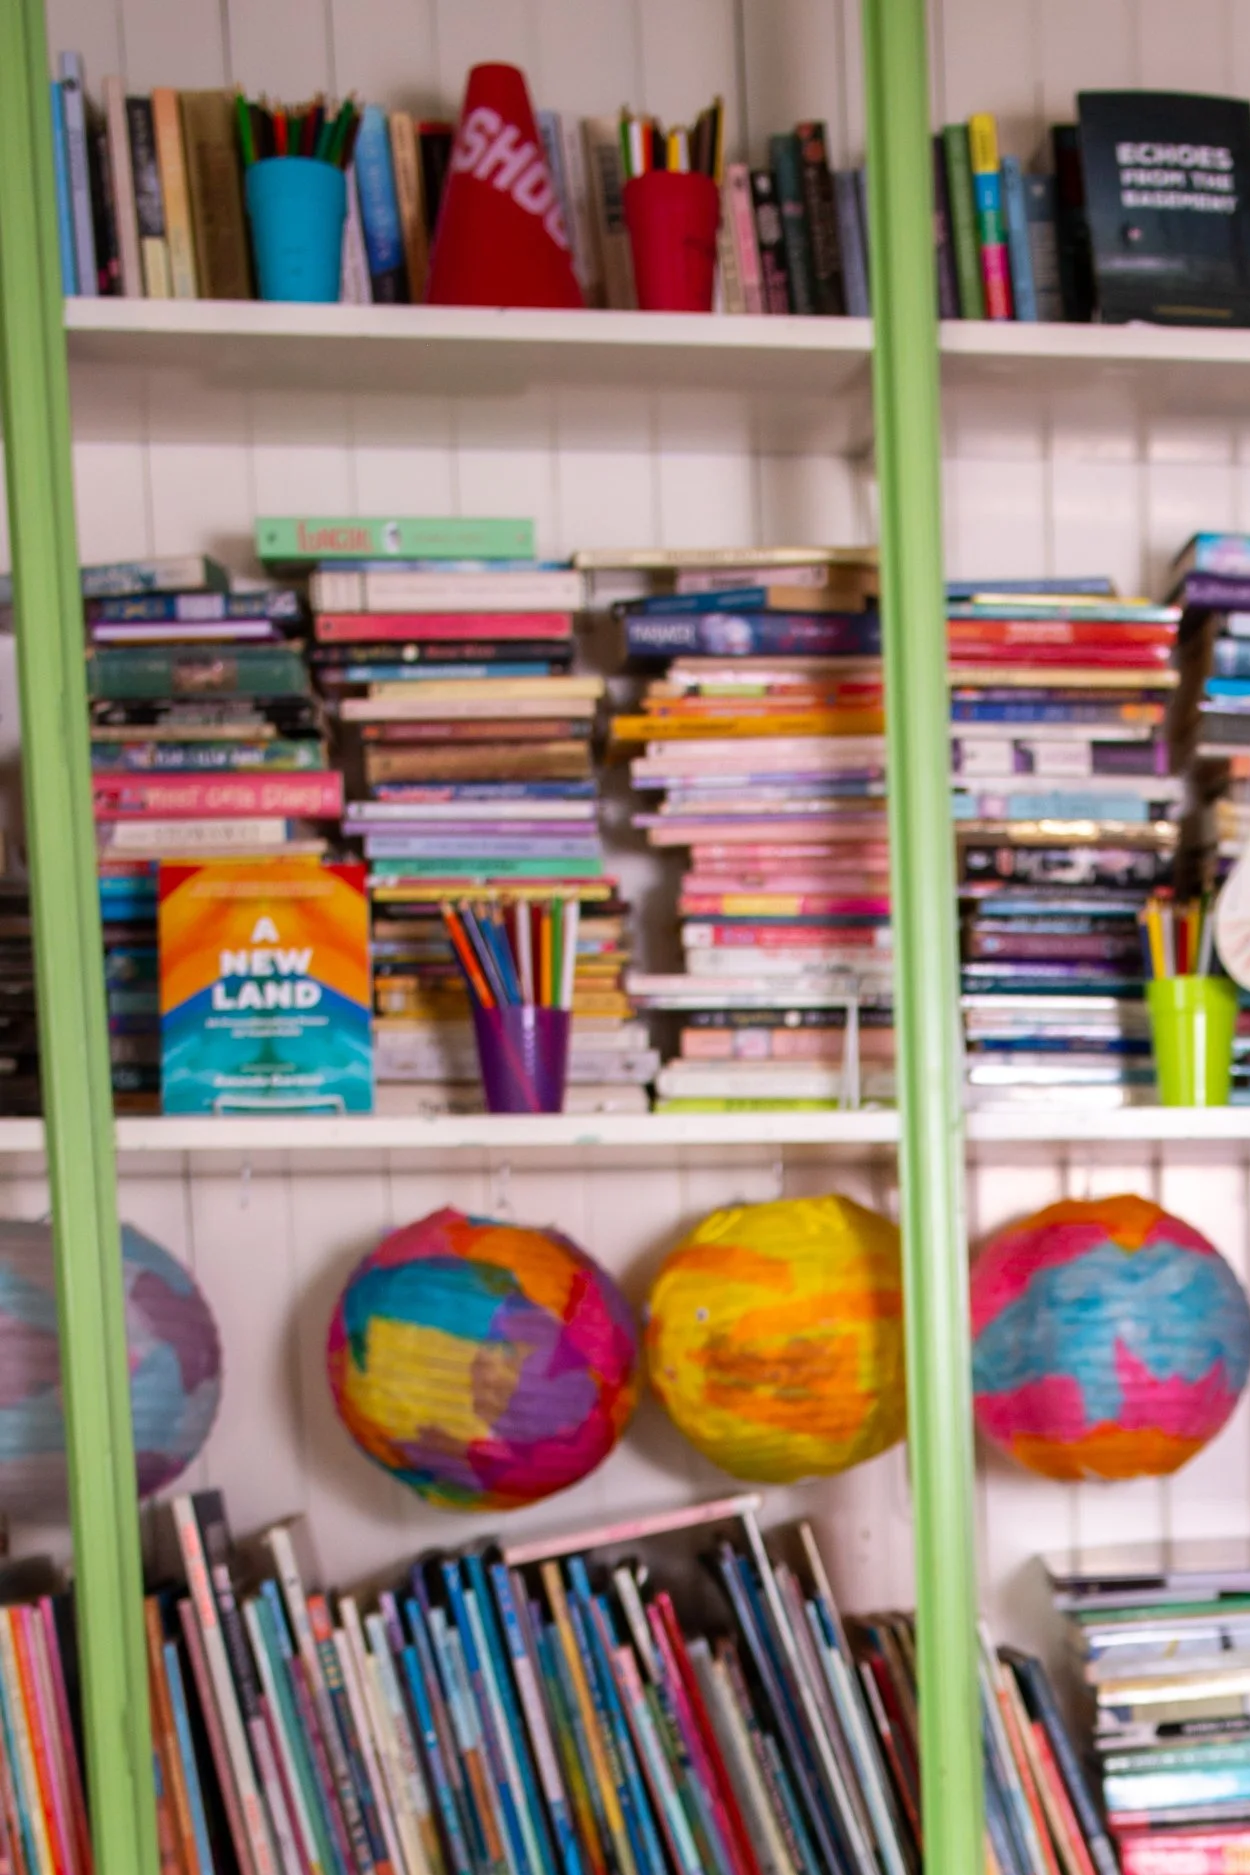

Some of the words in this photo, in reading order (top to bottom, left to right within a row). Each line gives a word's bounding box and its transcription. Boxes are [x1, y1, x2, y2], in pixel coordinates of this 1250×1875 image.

[1116, 142, 1234, 170] ECHOES
[1120, 167, 1186, 188] FROM
[1190, 171, 1235, 192] THE
[1121, 189, 1238, 214] BASEMENT
[251, 916, 279, 943] A
[219, 948, 313, 976] NEW
[212, 980, 322, 1010] LAND
